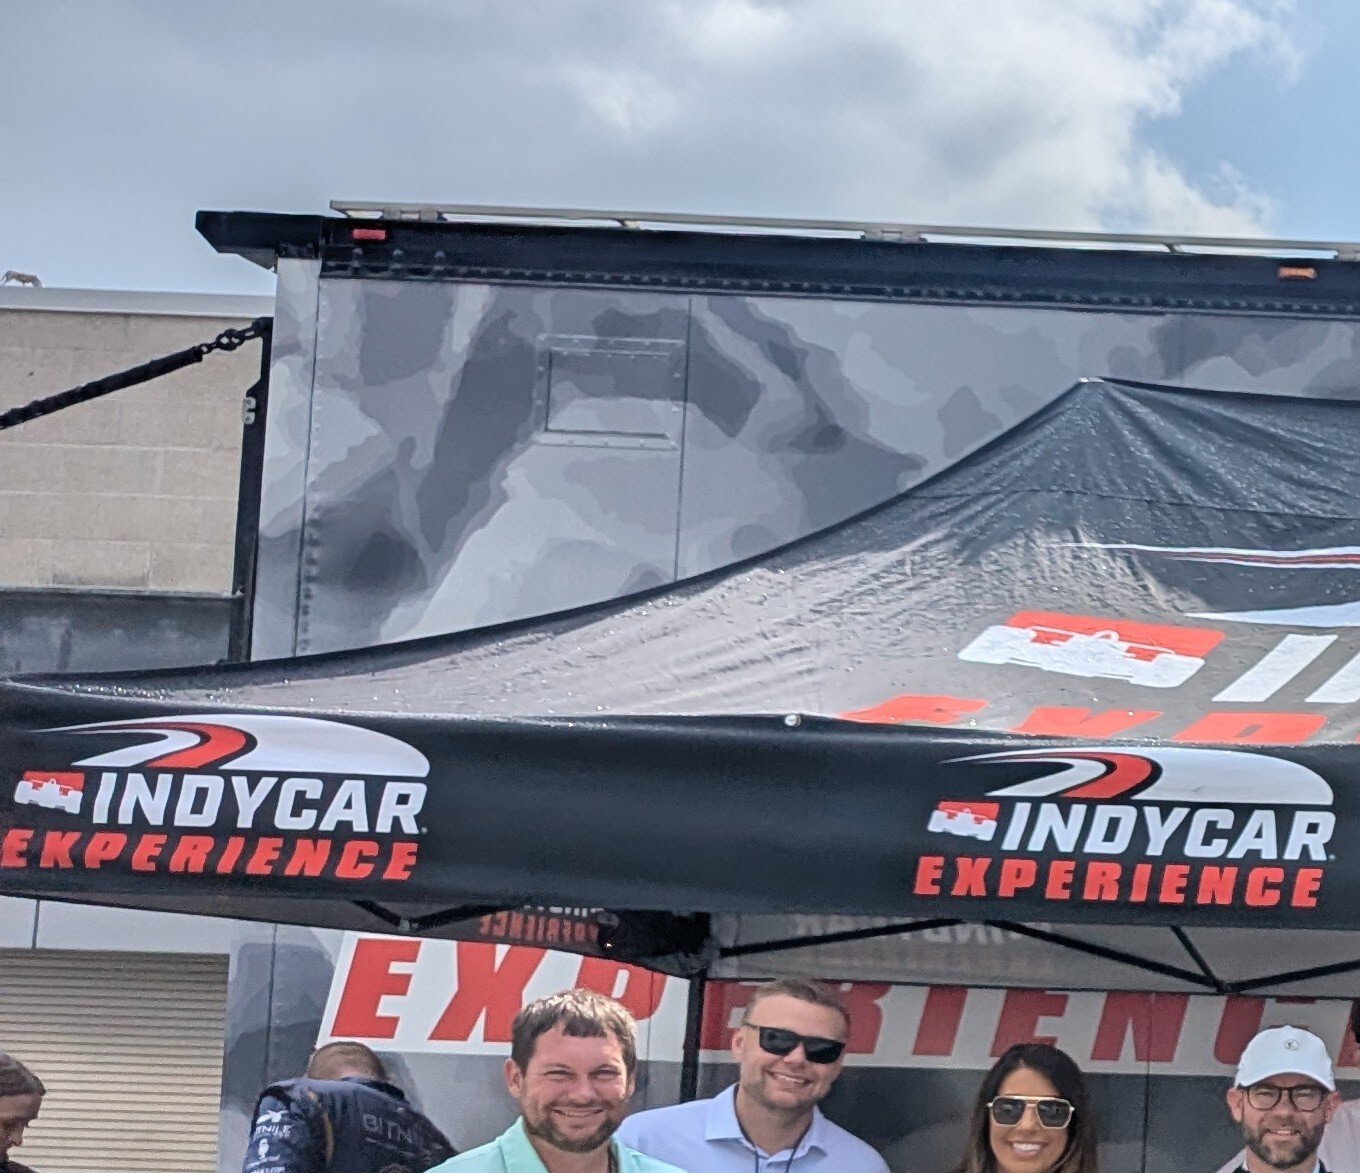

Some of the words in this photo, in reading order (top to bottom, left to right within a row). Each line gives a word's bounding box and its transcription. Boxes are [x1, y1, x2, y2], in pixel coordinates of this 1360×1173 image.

[92, 771, 428, 835] INDYCAR
[1000, 800, 1337, 861] INDYCAR
[2, 828, 419, 881] EXPERIENCE
[913, 854, 1326, 909] EXPERIENCE
